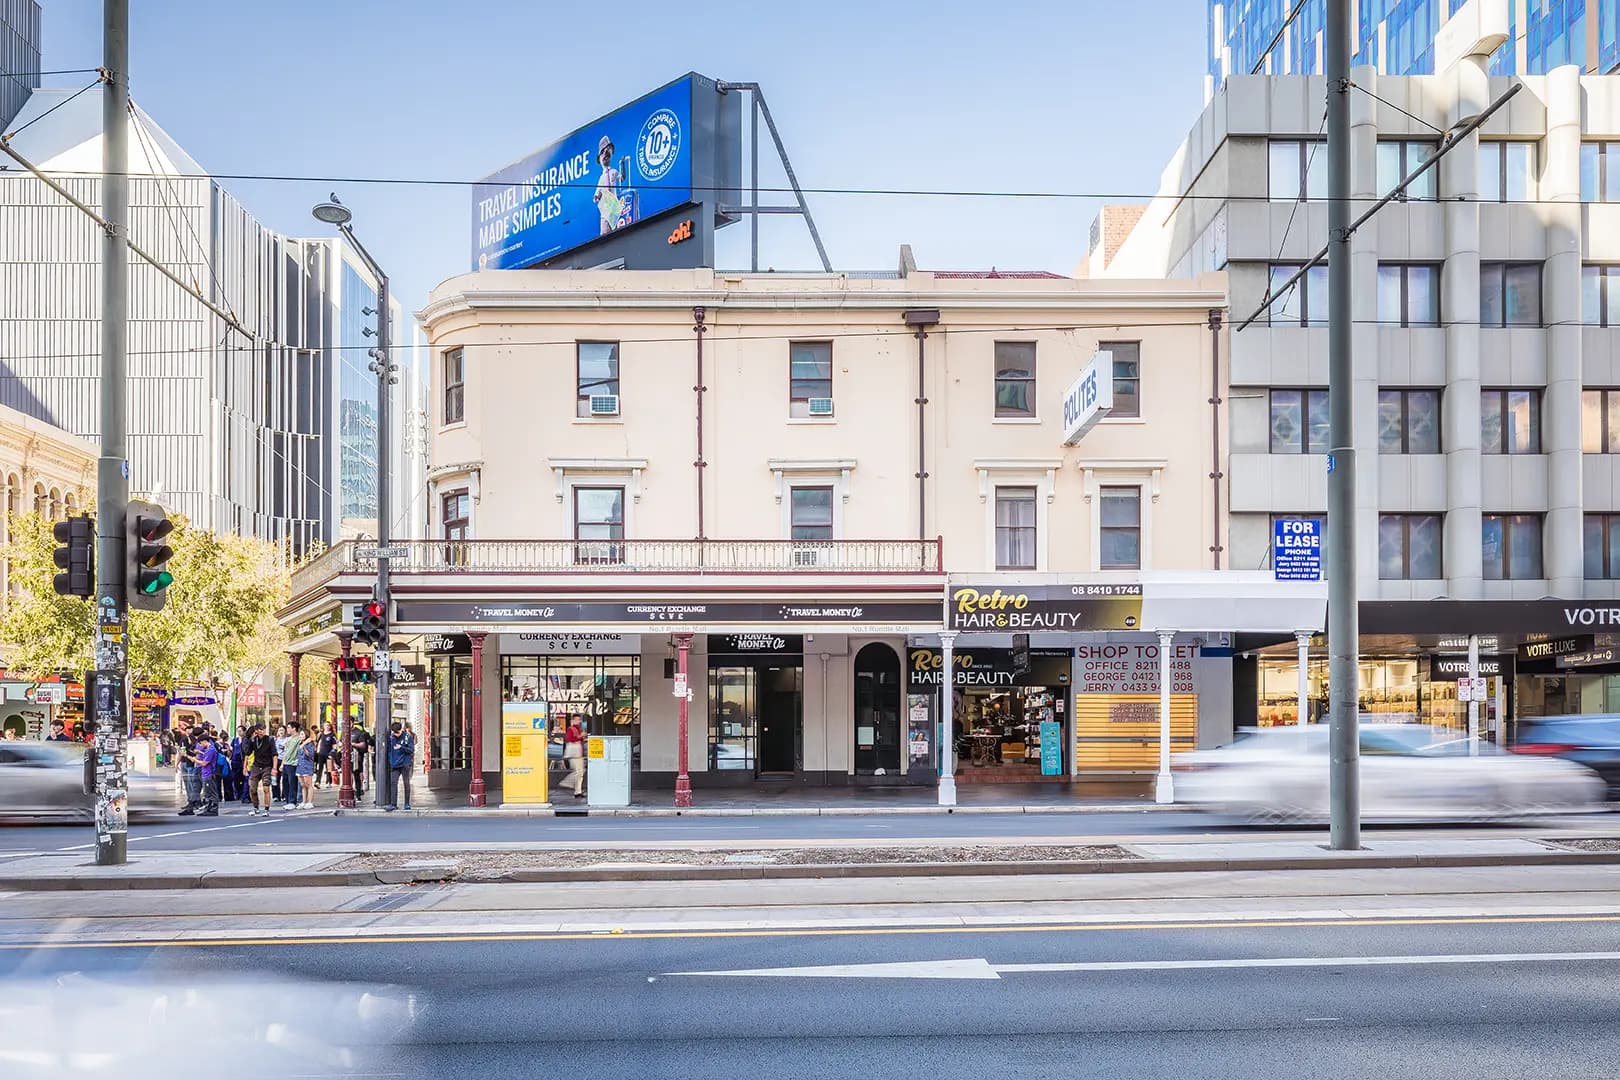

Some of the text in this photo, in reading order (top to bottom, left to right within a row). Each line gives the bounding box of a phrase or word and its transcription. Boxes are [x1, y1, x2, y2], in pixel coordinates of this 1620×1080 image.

[647, 113, 676, 130] COMPARE
[649, 131, 669, 154] 10+
[649, 144, 677, 177] INSURANCE
[479, 150, 590, 222] TRAVEL INSURANCE
[479, 192, 561, 249] MADE SIMPLES
[668, 219, 692, 244] ooh!
[1064, 369, 1097, 430] POLITES
[1283, 521, 1313, 534] FOR
[1276, 535, 1319, 547] LEASE
[1071, 586, 1140, 595] 08 8410 1744
[953, 588, 1028, 614] Retro
[483, 608, 513, 617] TRAVEL
[514, 608, 544, 617] MONEY
[627, 605, 706, 613] CURRENCY EXCHANGE
[790, 608, 821, 617] TRAVEL
[822, 608, 852, 617] MONEY
[1564, 608, 1620, 625] VOTR
[737, 637, 786, 650] MONEY Oz
[1526, 640, 1576, 657] VOTRE LUXE
[1078, 645, 1129, 659] SHOP
[1134, 645, 1159, 659] TO
[911, 649, 973, 671] Rero
[1085, 661, 1129, 670] OFFICE
[1135, 661, 1158, 670] 8211
[1438, 662, 1500, 673] VOTRE UXE
[1083, 672, 1126, 681] GEORGE
[1131, 672, 1154, 681] 0412
[1174, 672, 1193, 681] 968
[1083, 683, 1116, 692] JERRY
[1121, 683, 1148, 692] 0433
[1173, 683, 1194, 692] 008
